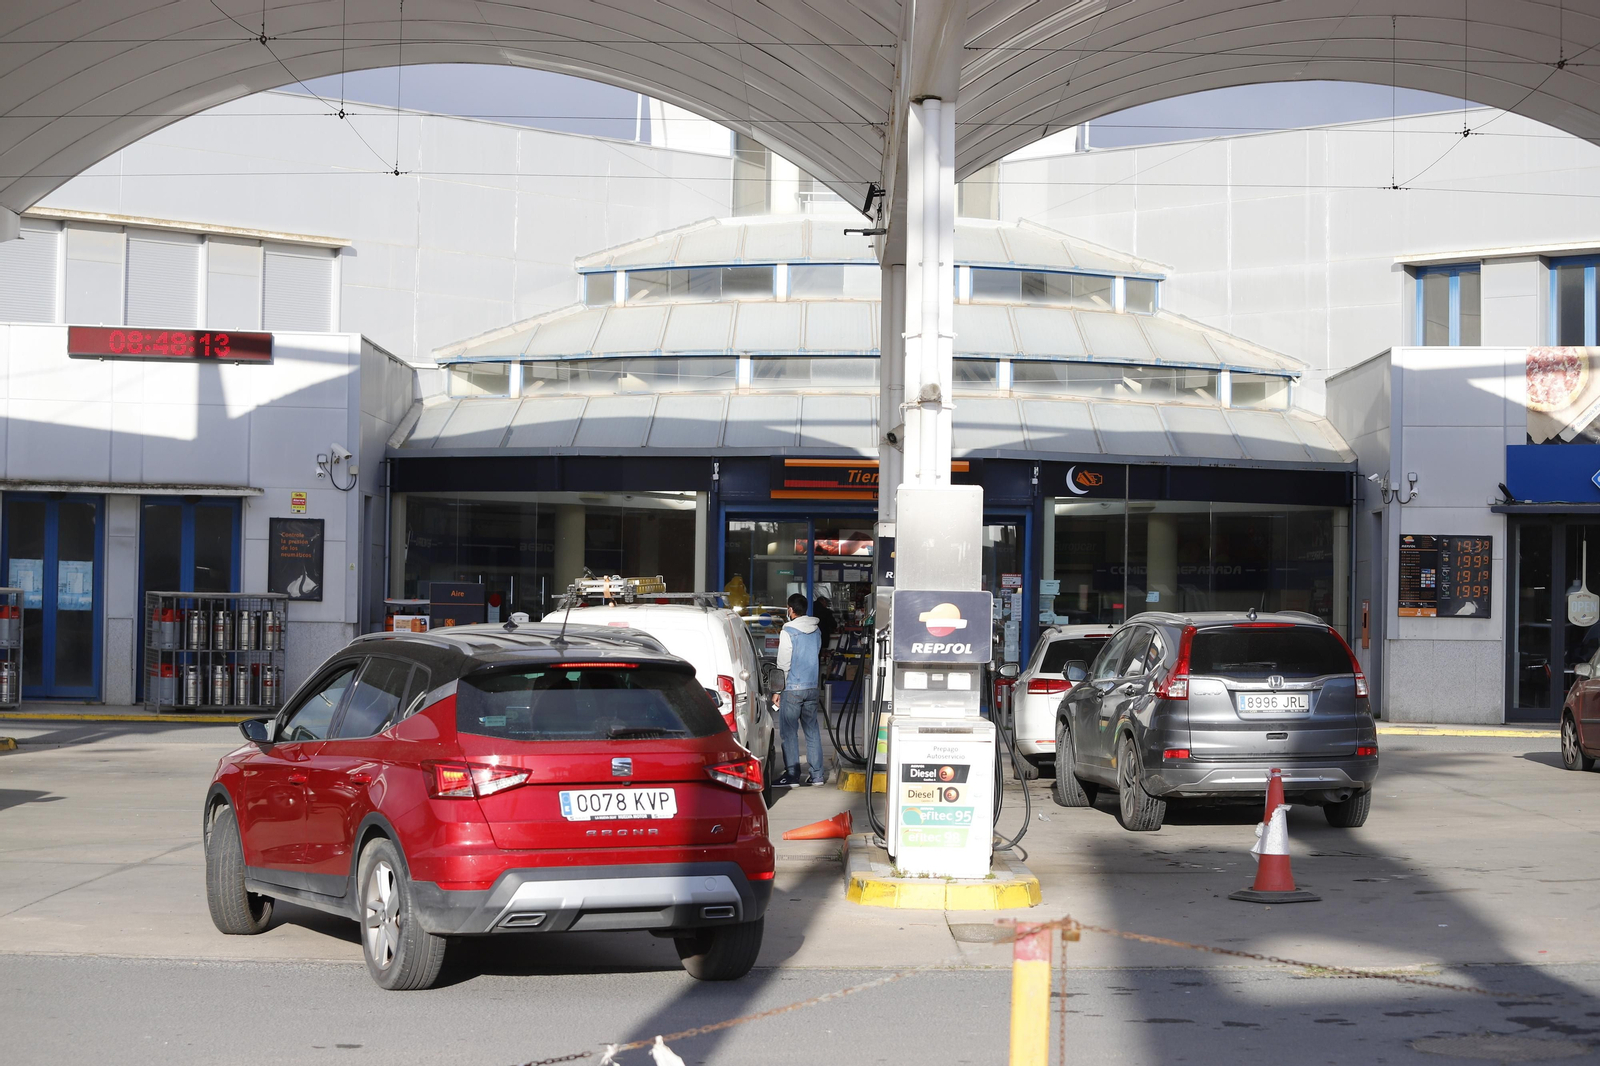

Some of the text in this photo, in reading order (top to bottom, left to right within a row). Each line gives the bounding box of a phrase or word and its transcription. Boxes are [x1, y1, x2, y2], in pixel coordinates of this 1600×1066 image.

[450, 590, 465, 598] Aire
[1571, 601, 1597, 612] OPEN
[911, 642, 973, 654] REPSOL
[1247, 696, 1305, 708] 8996 JRL
[933, 745, 959, 753] Prepago
[910, 768, 937, 778] Diesel
[907, 789, 934, 799] Diesel
[576, 792, 670, 813] 0078 KVP
[919, 810, 972, 823] efitec 95
[586, 828, 659, 837] ARONA
[908, 833, 942, 843] efitec
